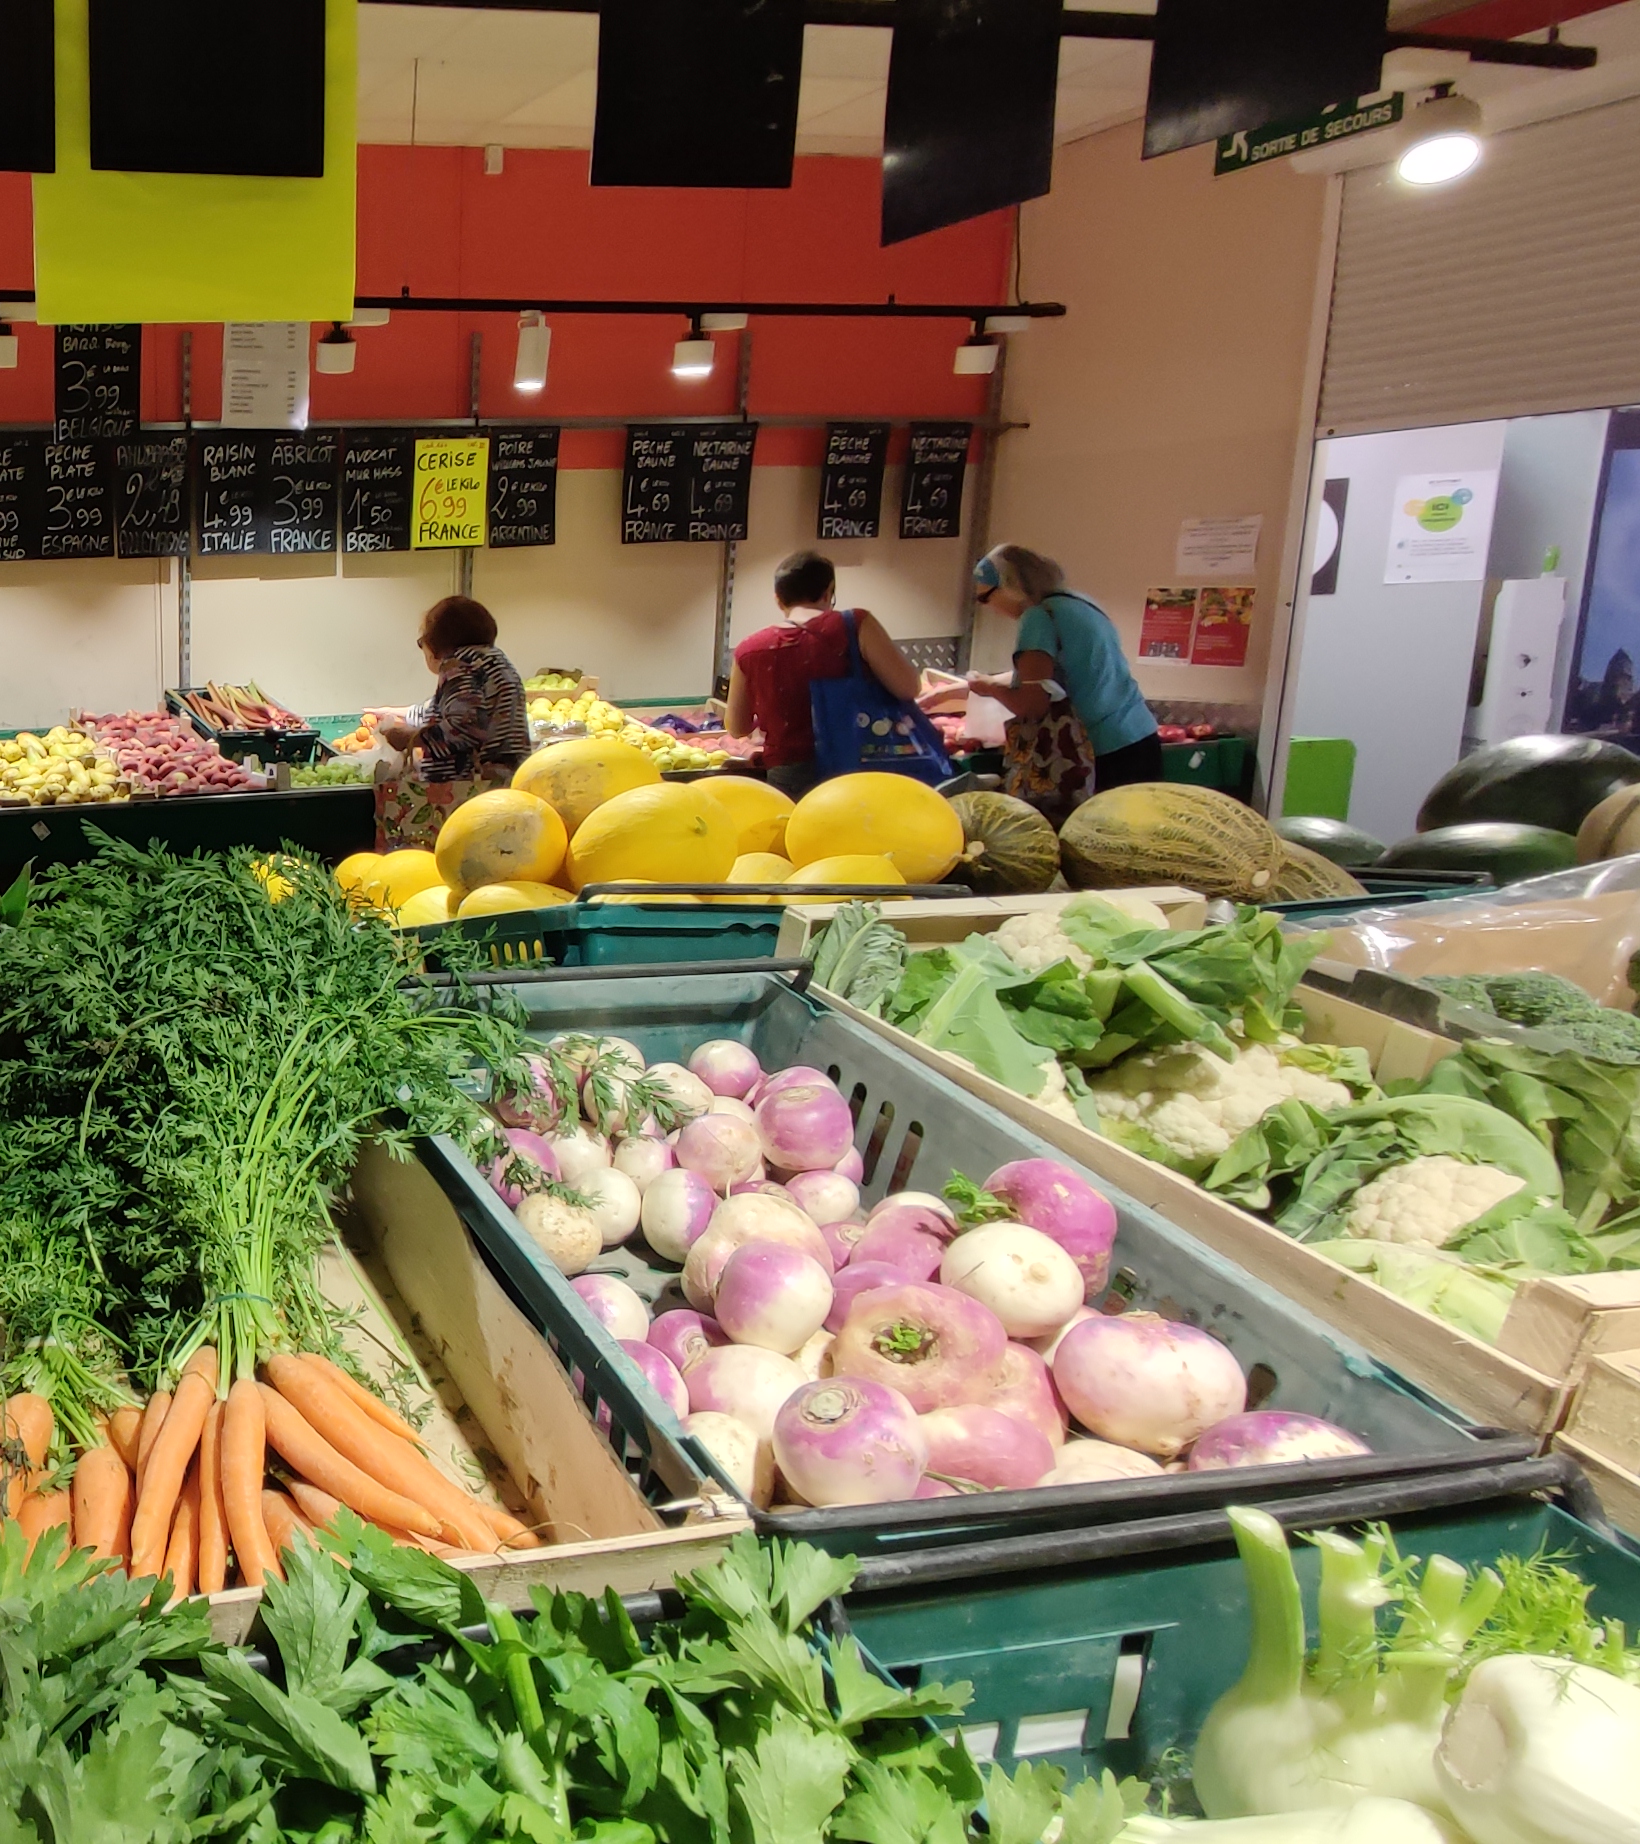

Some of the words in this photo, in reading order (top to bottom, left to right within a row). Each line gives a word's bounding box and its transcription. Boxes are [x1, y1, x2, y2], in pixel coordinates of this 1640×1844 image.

[1251, 132, 1297, 162] SORTIE
[1301, 126, 1320, 146] DE
[1323, 104, 1393, 139] SECOURS
[58, 416, 134, 444] BELGIQUE
[498, 440, 534, 457] POIRE
[631, 440, 673, 456] PECHE
[692, 440, 752, 457] NECTARINE
[829, 435, 871, 451] PECHE
[44, 444, 94, 467] PECHE
[203, 442, 257, 467] RAISIN
[271, 444, 337, 466] ABRICOT
[344, 447, 398, 465] AVOCAT
[417, 450, 477, 472] CERISE
[637, 455, 677, 469] JAUNE
[702, 457, 740, 472] JAUNE
[827, 452, 873, 465] BLANCHE
[50, 461, 97, 481] PLATE
[210, 462, 256, 482] BLANC
[345, 467, 370, 483] MUR
[373, 465, 402, 481] HASS
[446, 477, 458, 492] LE
[419, 521, 481, 543] FRANCE
[490, 523, 550, 544] ARGENTINE
[625, 520, 677, 542] FRANCE
[689, 521, 743, 541] FRANCE
[822, 516, 874, 538] FRANCE
[903, 516, 950, 537] FRANCE
[41, 534, 110, 556] ESPAGNE
[201, 529, 256, 553] ITALIE
[270, 527, 333, 553] FRANCE
[346, 531, 395, 552] BRESIL
[2, 548, 26, 560] SUD
